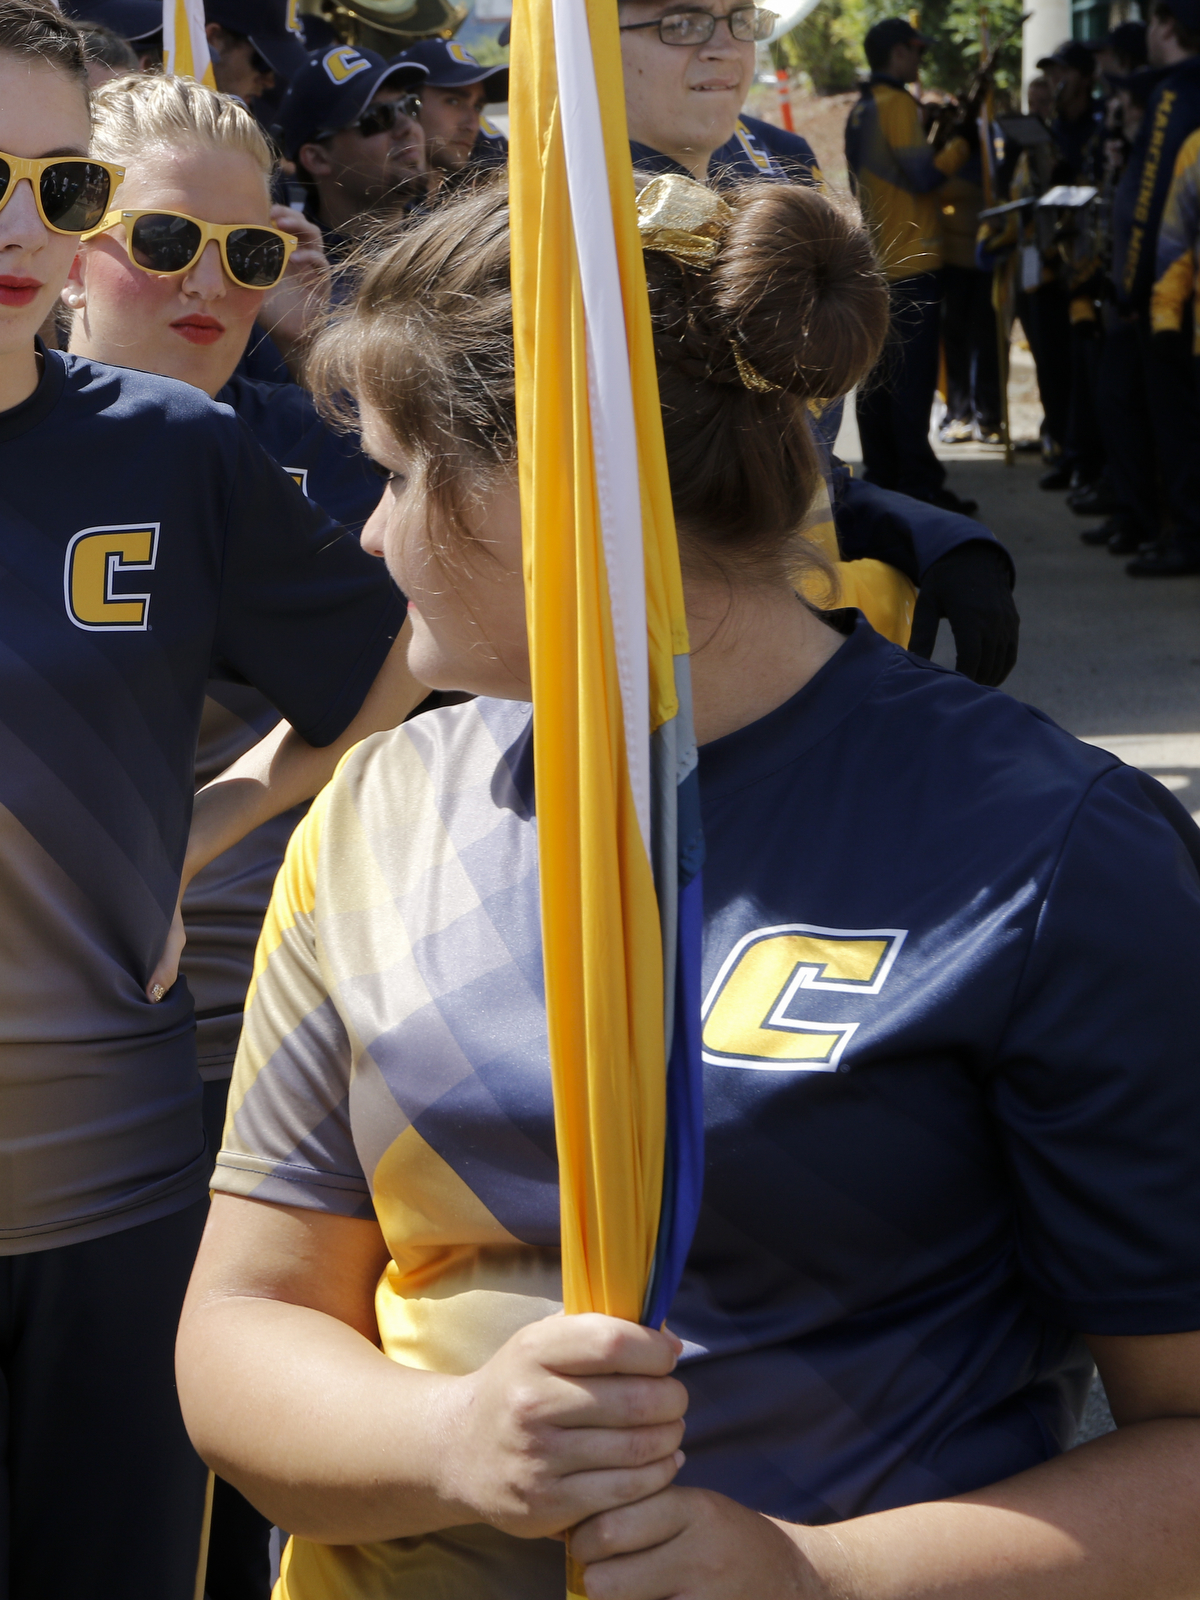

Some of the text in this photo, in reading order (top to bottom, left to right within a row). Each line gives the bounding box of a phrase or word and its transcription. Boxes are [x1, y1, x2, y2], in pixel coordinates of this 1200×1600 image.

[322, 45, 372, 85] C
[1134, 89, 1177, 223] MARCHING
[63, 522, 160, 632] C
[701, 923, 909, 1073] C
